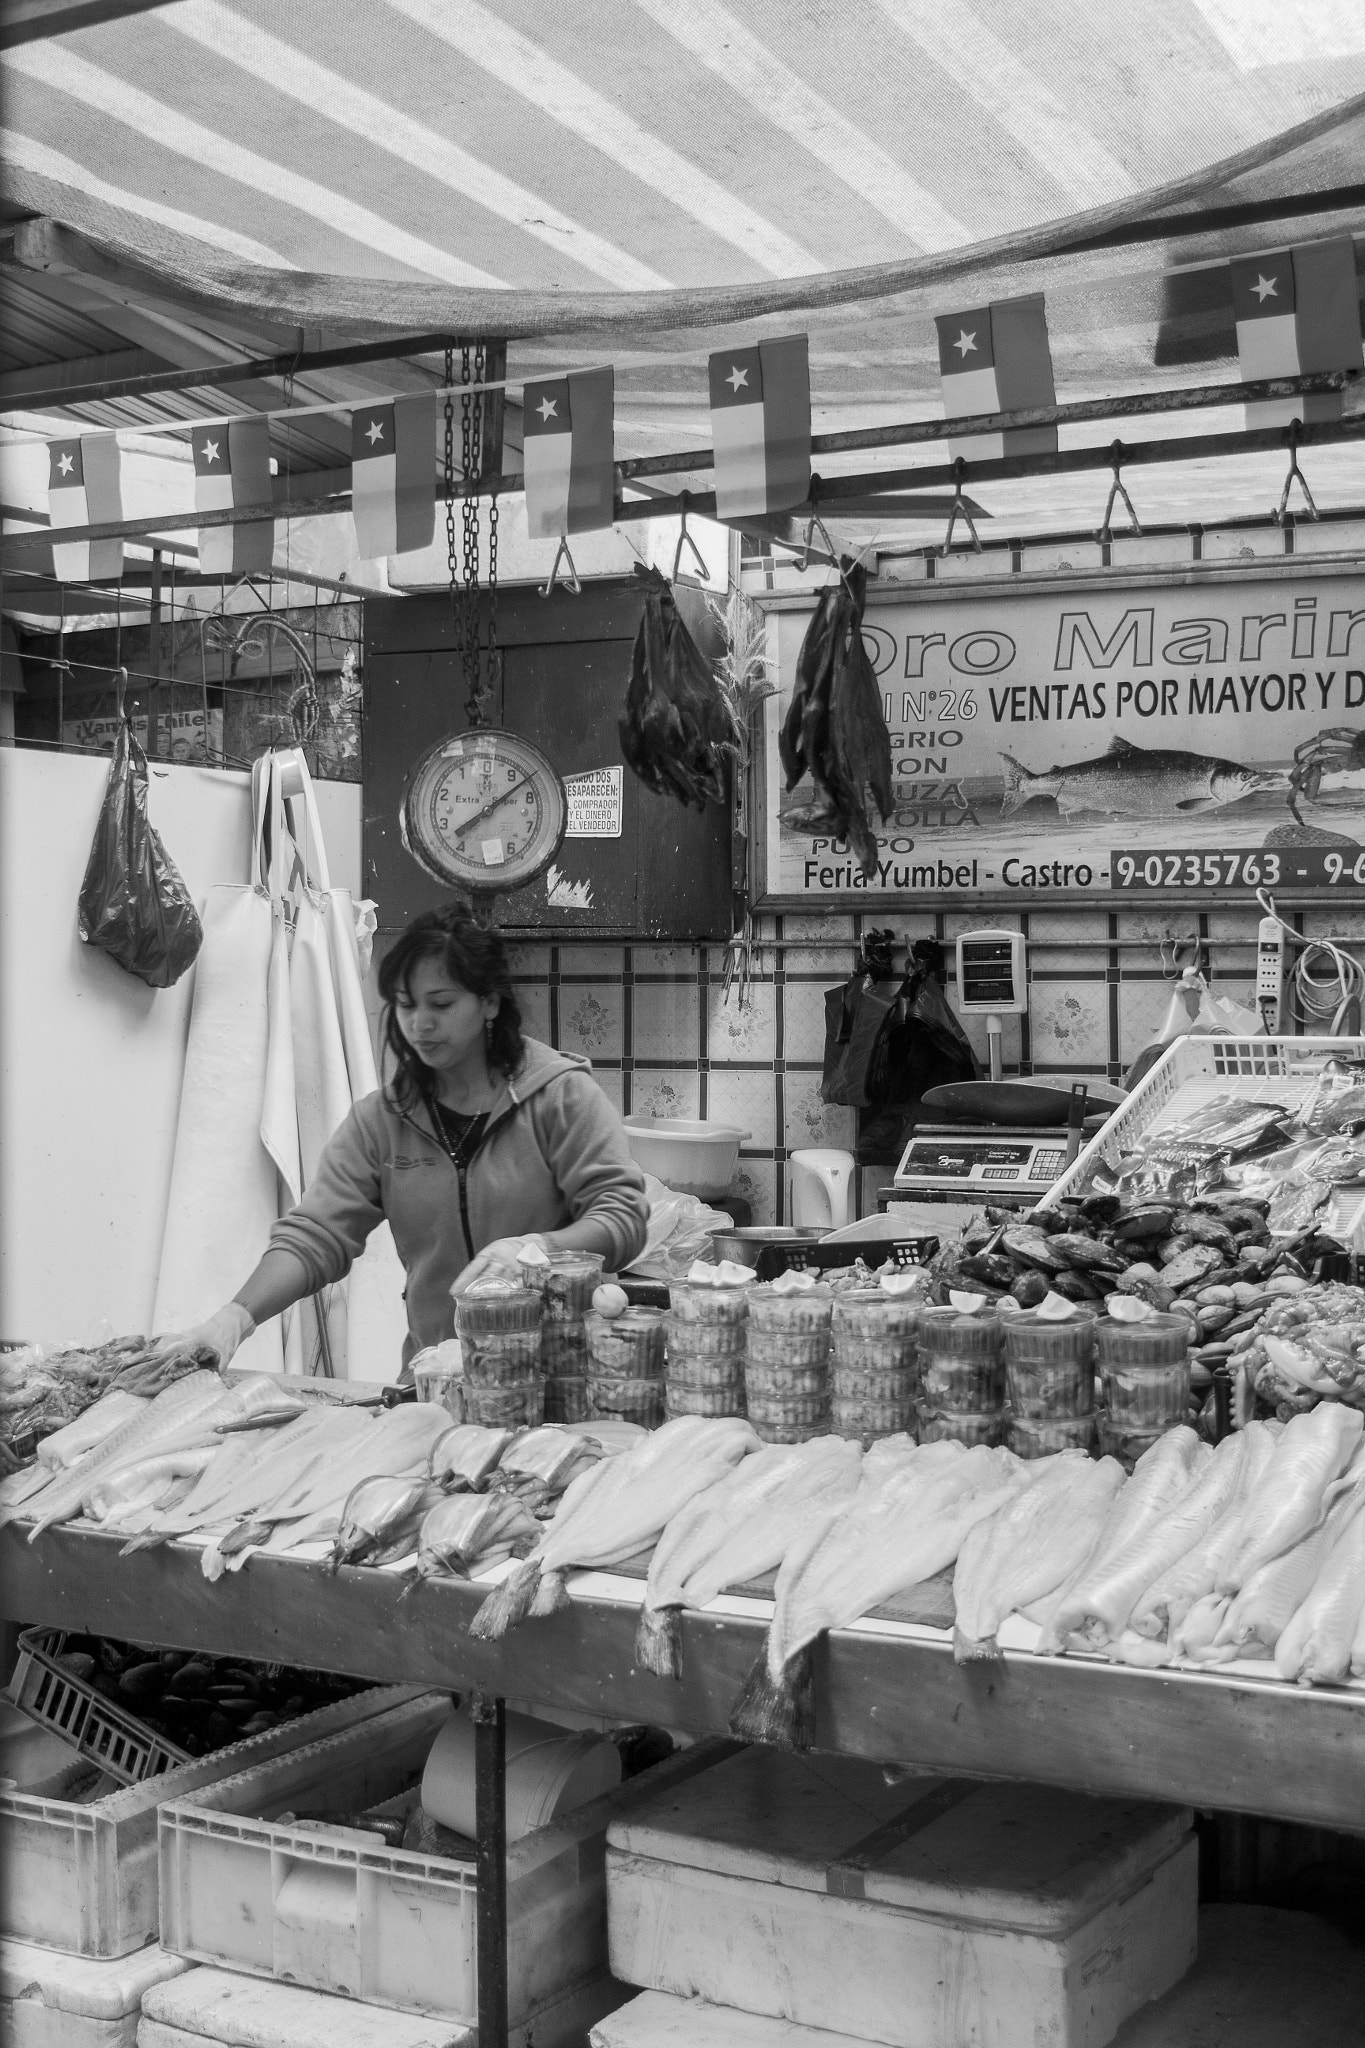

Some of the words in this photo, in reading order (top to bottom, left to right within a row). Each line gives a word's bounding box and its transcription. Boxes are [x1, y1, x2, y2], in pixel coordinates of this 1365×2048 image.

[988, 682, 1106, 723] VENTAS
[1116, 679, 1179, 718] POR
[1188, 673, 1306, 715] MAYOR
[1315, 671, 1336, 710] Y
[889, 730, 964, 749] GRIO
[507, 769, 516, 782] 9
[596, 771, 612, 784] DOS
[440, 788, 449, 801] 2
[455, 795, 480, 804] Extra
[491, 796, 518, 806] Sper
[525, 791, 534, 805] 8
[573, 799, 619, 810] COMPRADOR
[575, 810, 584, 820] EL
[585, 810, 612, 820] DINERO
[440, 817, 449, 830] 3
[526, 821, 534, 834] 7
[578, 820, 617, 830] VENDEDOR
[812, 837, 914, 855] PUPO
[804, 860, 868, 888] Feria
[876, 859, 978, 888] Yumbel
[1002, 858, 1093, 888] Castro
[1116, 854, 1281, 887] 9-0235763
